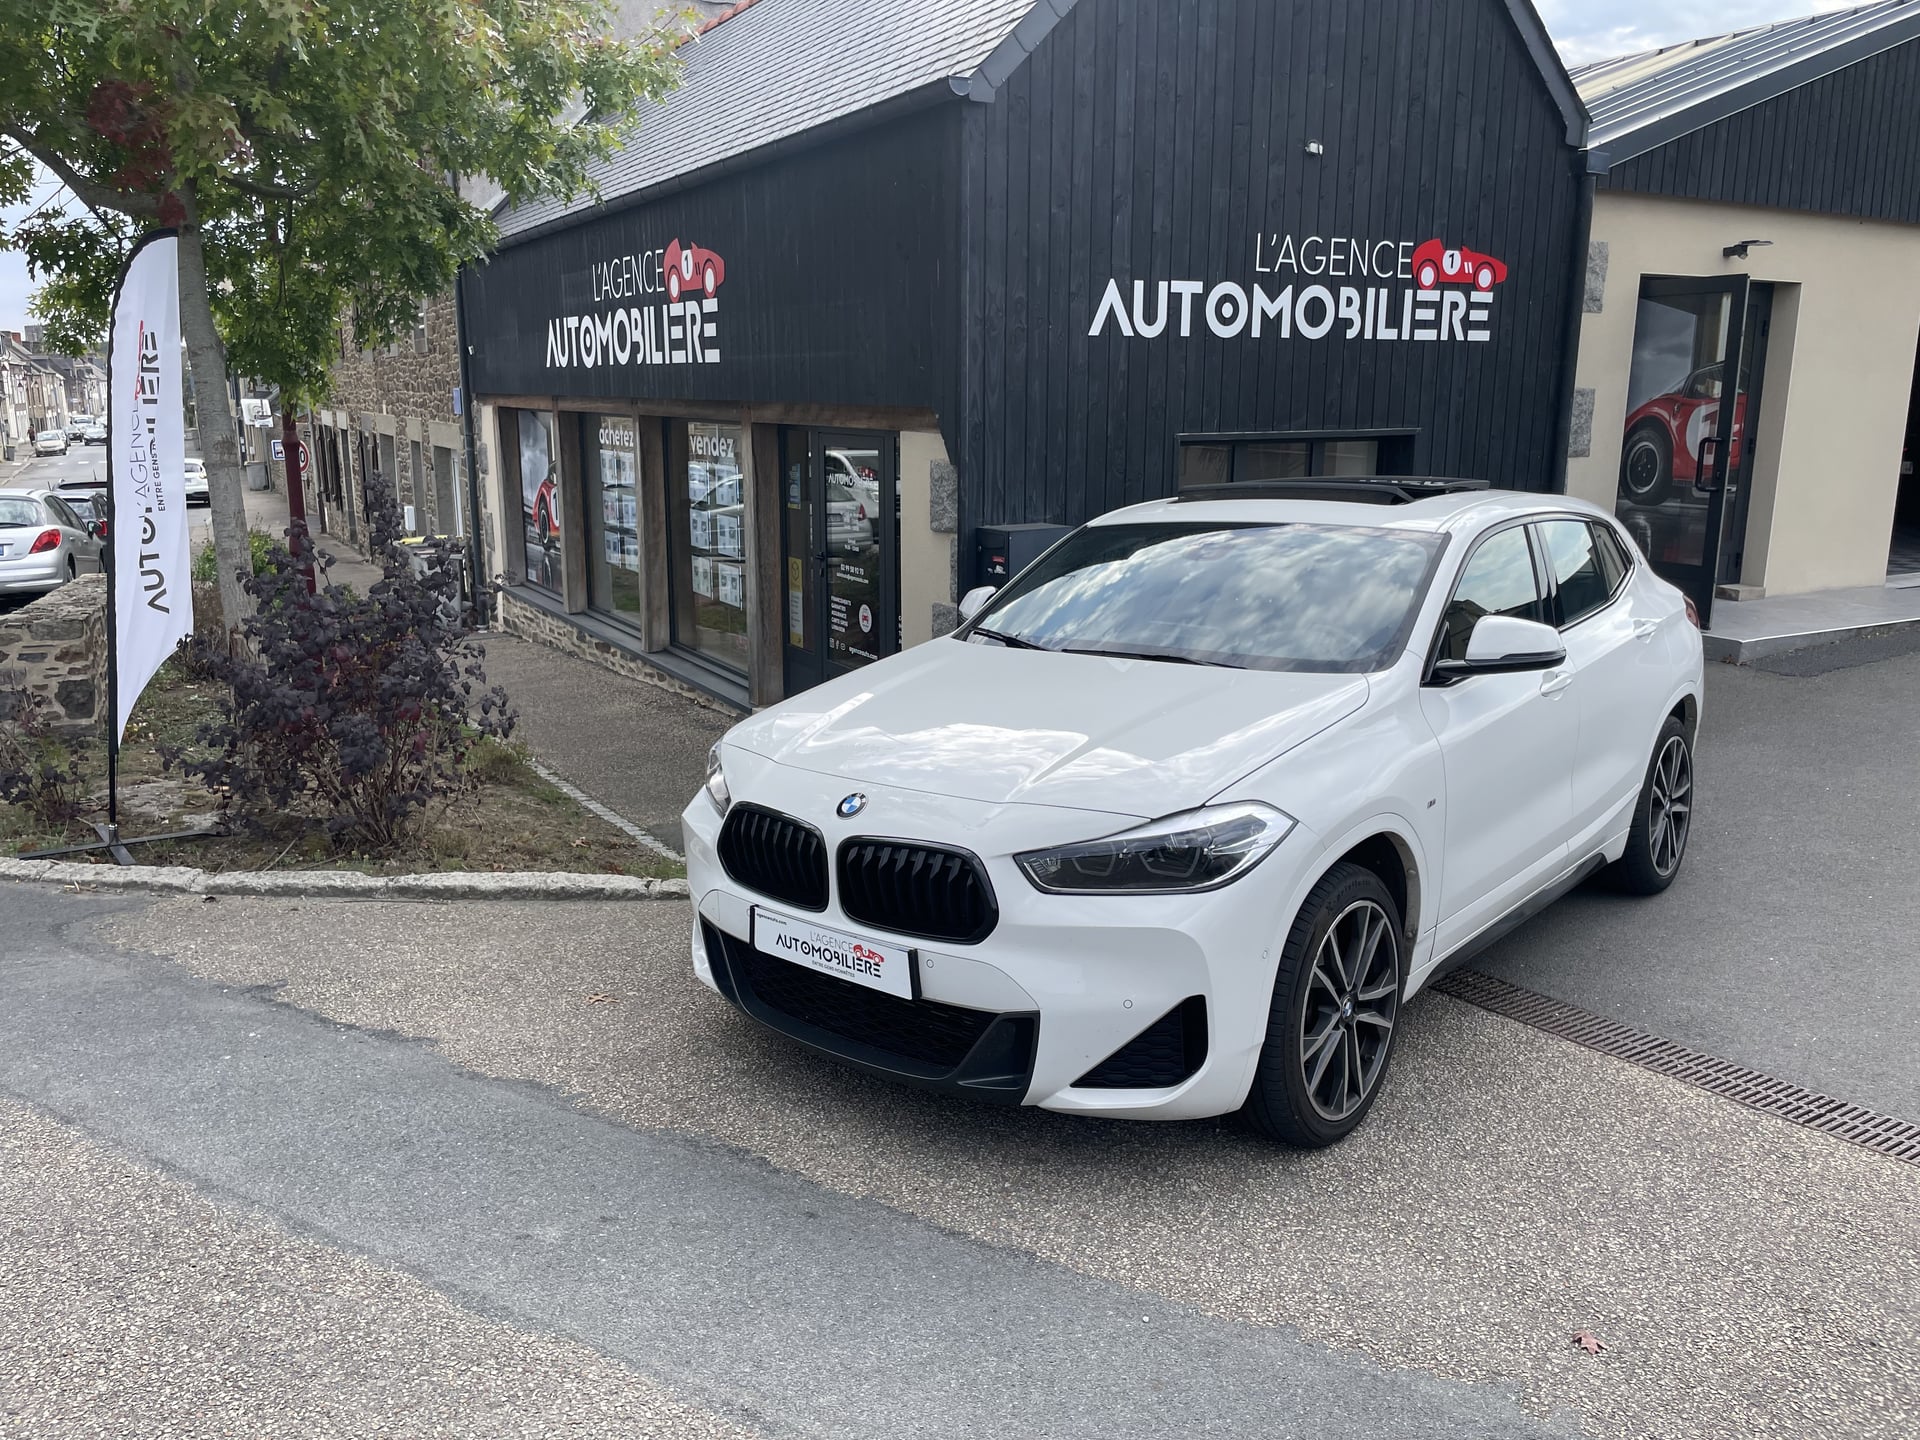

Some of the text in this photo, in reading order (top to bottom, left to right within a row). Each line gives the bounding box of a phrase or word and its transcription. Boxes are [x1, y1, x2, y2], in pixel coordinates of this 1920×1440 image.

[1255, 233, 1414, 279] L'AGENCE
[592, 249, 665, 301] L'AGENCE
[599, 418, 634, 447] achetez
[689, 424, 735, 458] vendez
[154, 481, 166, 512] ENTRE
[810, 930, 854, 954] L'AGENCE
